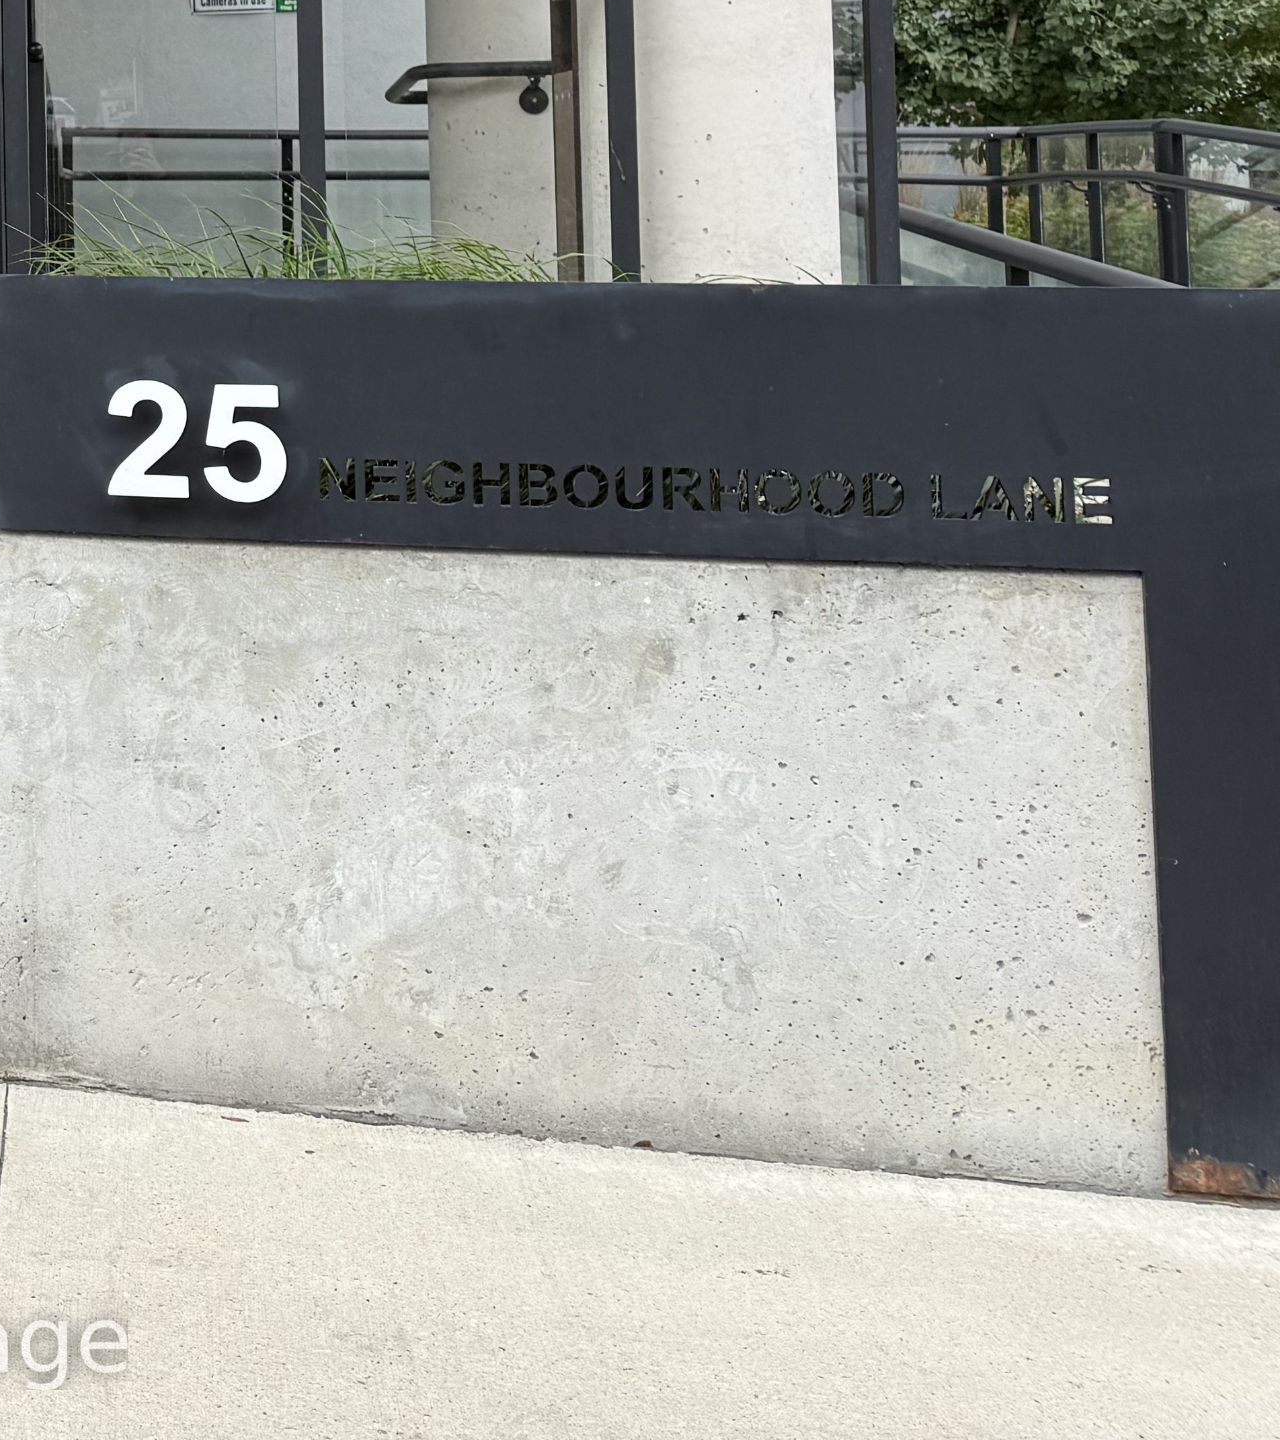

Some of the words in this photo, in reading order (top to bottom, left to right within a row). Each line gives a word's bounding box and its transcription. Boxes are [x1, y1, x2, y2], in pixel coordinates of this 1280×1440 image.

[107, 379, 287, 503] 25
[318, 456, 905, 519] NEIGHBOURHOOD
[929, 473, 1114, 526] LANE
